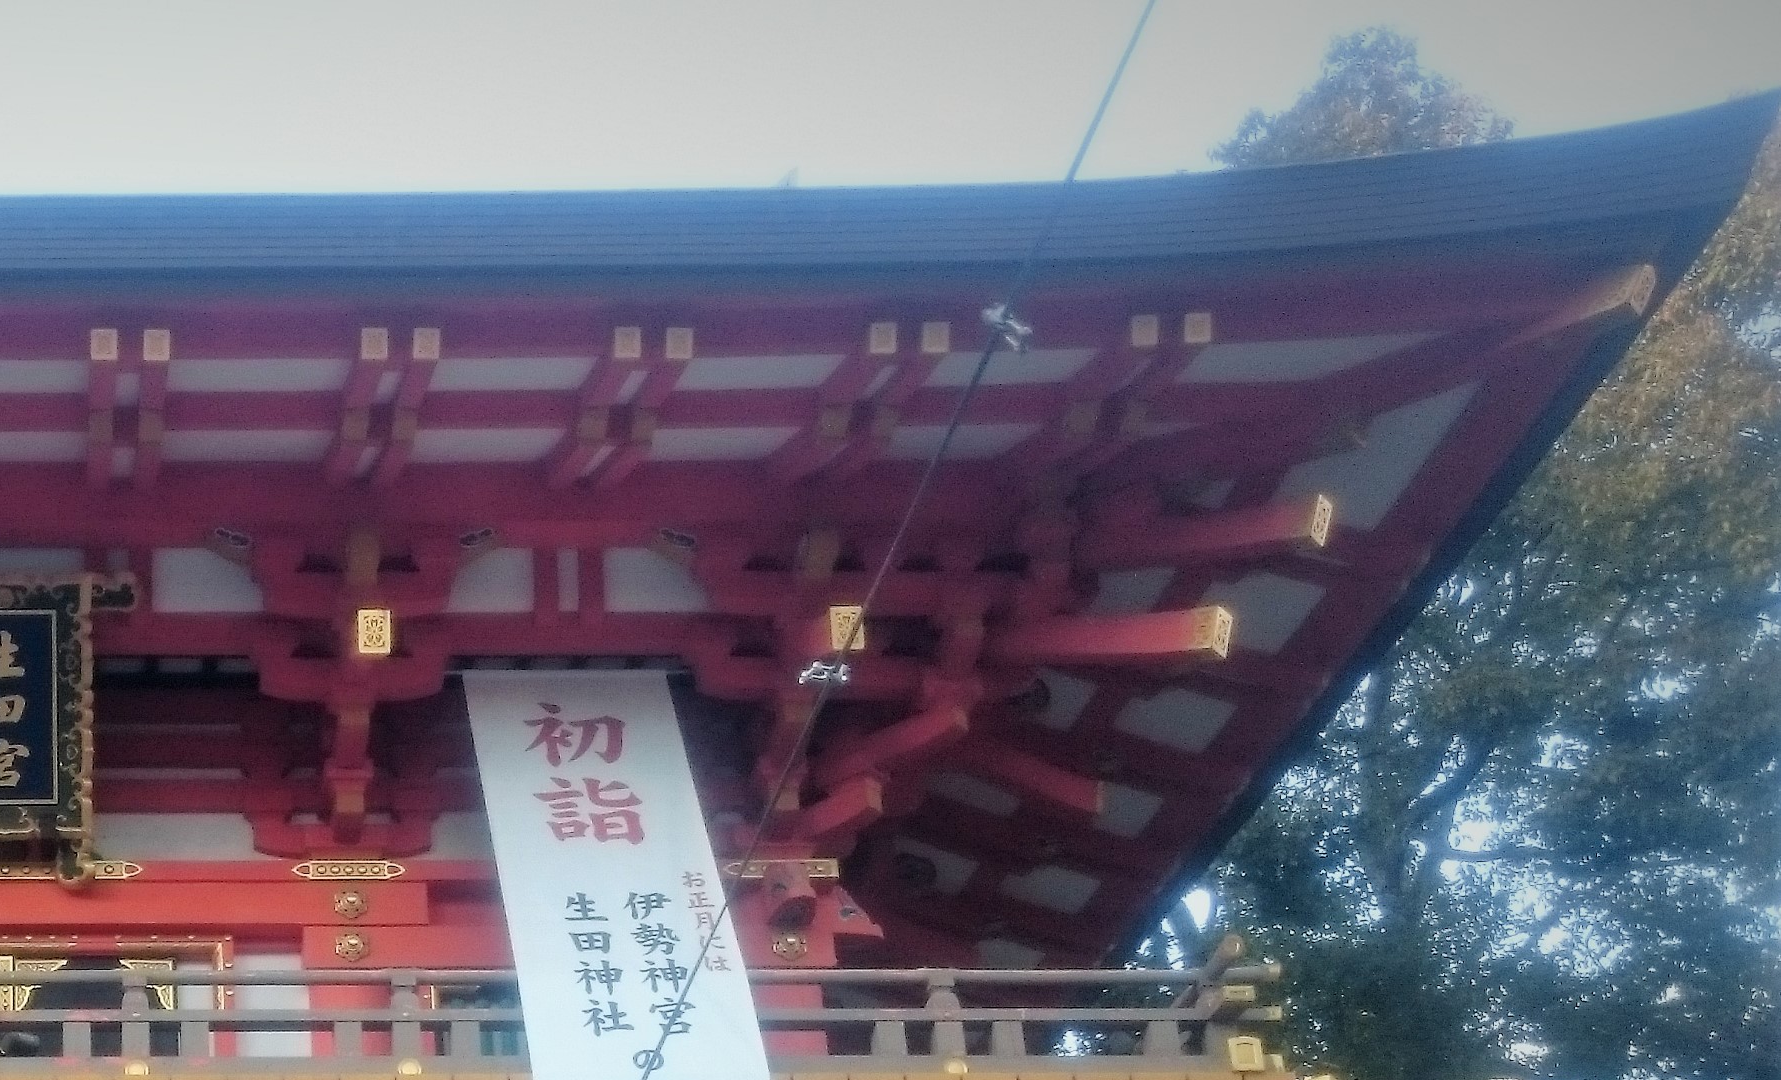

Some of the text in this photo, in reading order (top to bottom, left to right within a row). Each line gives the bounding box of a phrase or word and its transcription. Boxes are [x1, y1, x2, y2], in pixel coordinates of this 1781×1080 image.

[524, 702, 647, 845] 初詣
[565, 892, 635, 1036] 生田神社
[623, 891, 697, 1035] 伊勢神宮
[682, 871, 731, 972] お正月には
